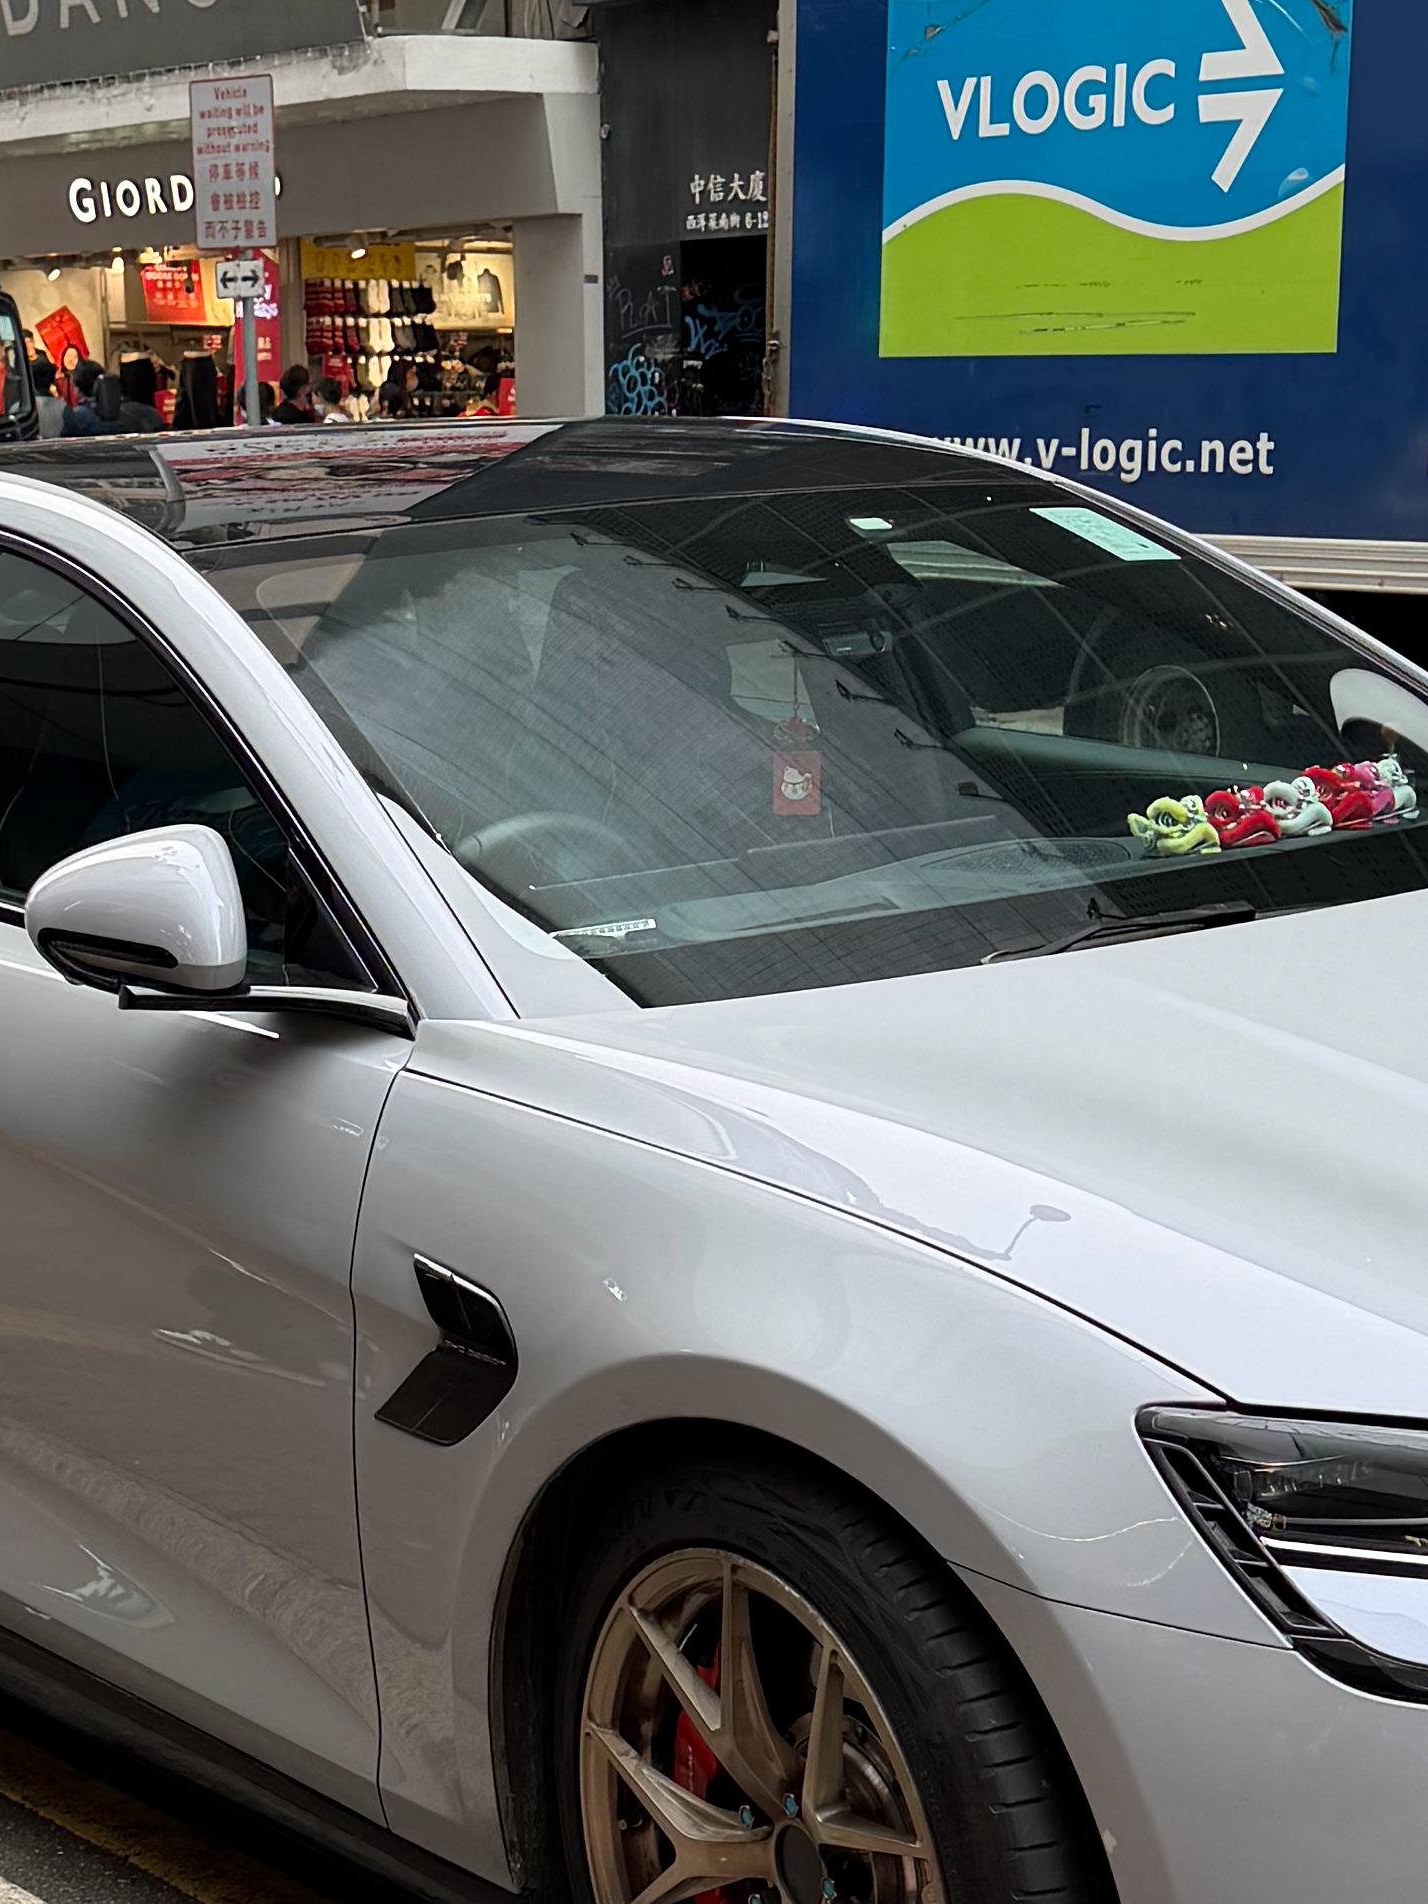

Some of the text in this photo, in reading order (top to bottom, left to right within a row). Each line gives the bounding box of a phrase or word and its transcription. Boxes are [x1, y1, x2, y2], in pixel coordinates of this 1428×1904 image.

[936, 57, 1176, 142] VLOGIC
[209, 161, 260, 183] 停車等候
[690, 170, 768, 205] 中信大廈
[69, 173, 282, 224] GIORD
